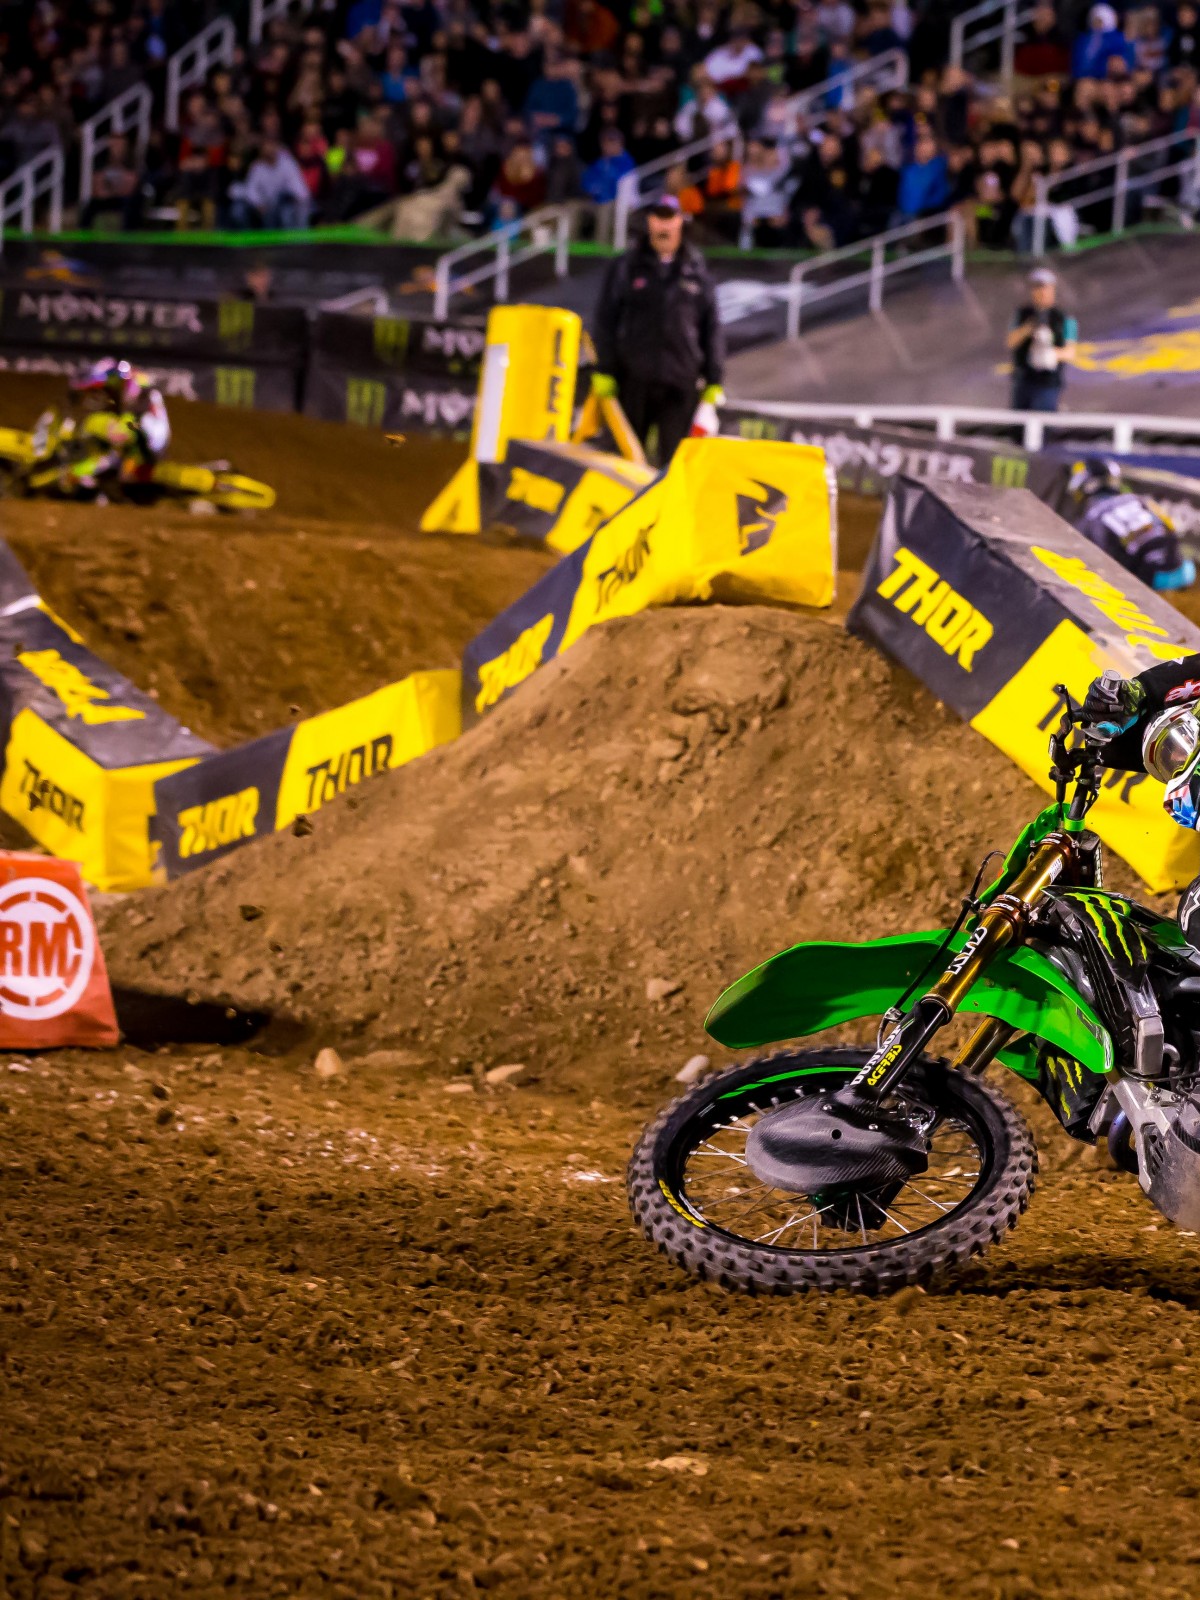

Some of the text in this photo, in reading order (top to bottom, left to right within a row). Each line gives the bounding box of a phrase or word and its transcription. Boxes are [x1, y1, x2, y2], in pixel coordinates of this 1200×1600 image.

[874, 546, 994, 673] THOR
[306, 733, 394, 808] THOR
[178, 785, 260, 859] THOR
